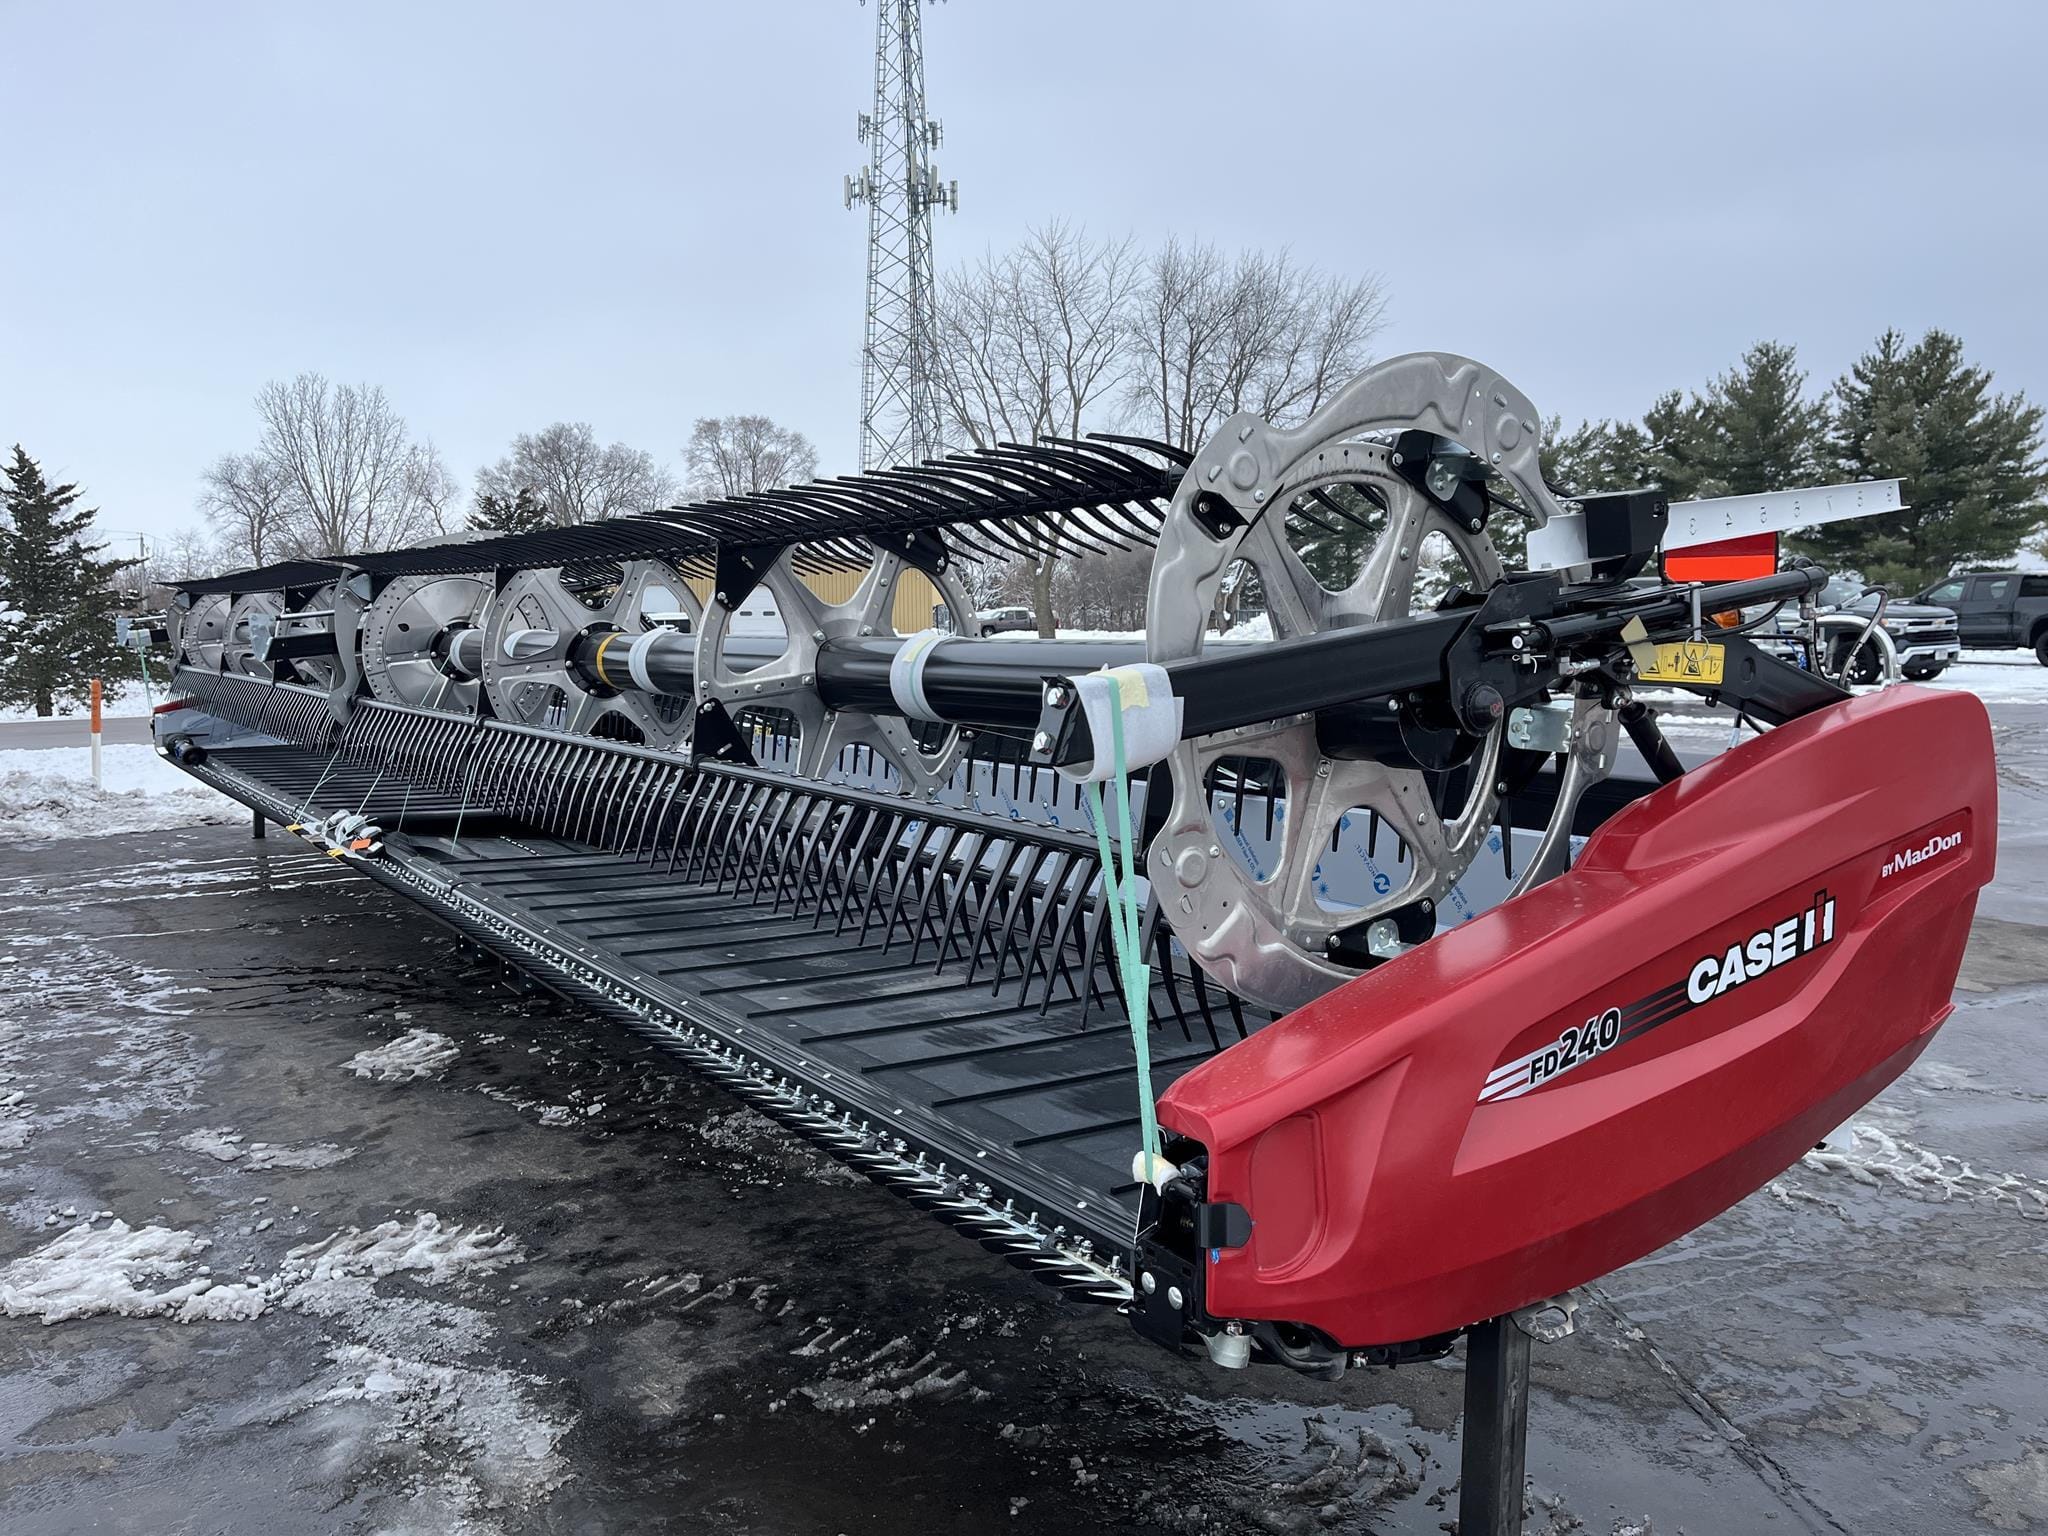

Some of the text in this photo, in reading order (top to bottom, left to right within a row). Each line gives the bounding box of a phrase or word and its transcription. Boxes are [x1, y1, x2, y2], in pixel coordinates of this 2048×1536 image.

[1882, 831, 1962, 878] BY MacDon
[1687, 917, 1799, 1004] CASE
[1529, 1007, 1621, 1085] FD240
